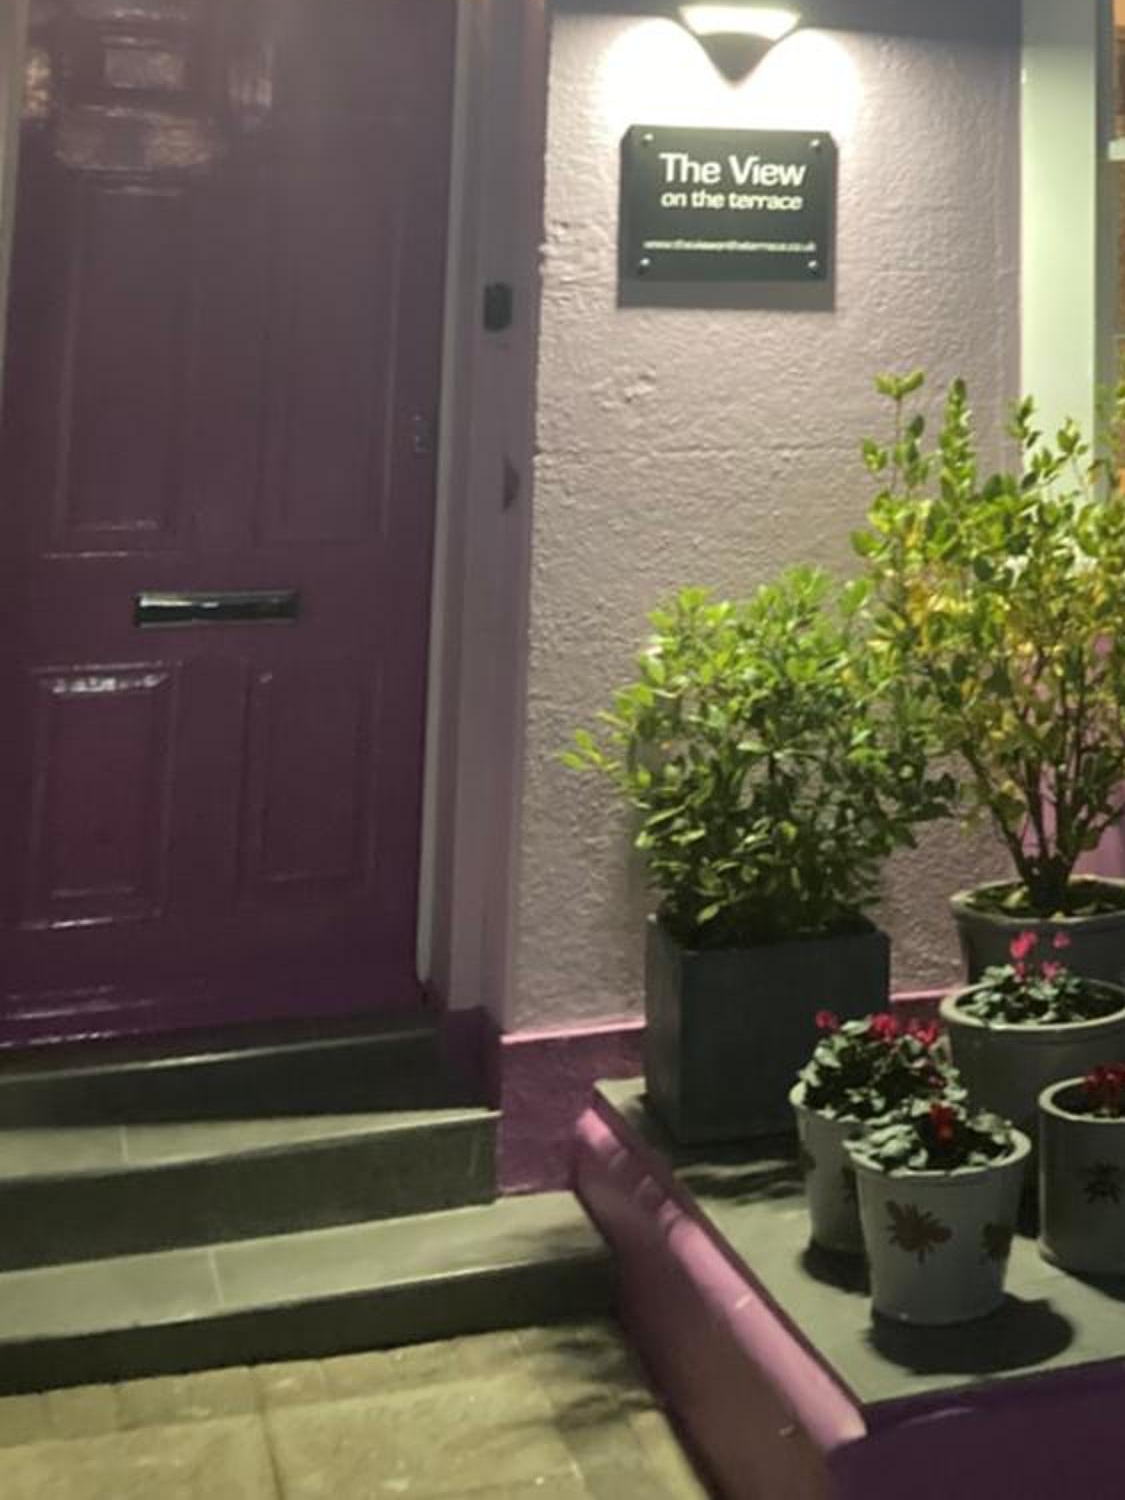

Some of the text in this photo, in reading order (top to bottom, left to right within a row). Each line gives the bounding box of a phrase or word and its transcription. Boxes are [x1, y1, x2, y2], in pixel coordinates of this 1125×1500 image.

[659, 152, 806, 186] The View
[660, 189, 803, 211] on the terrace
